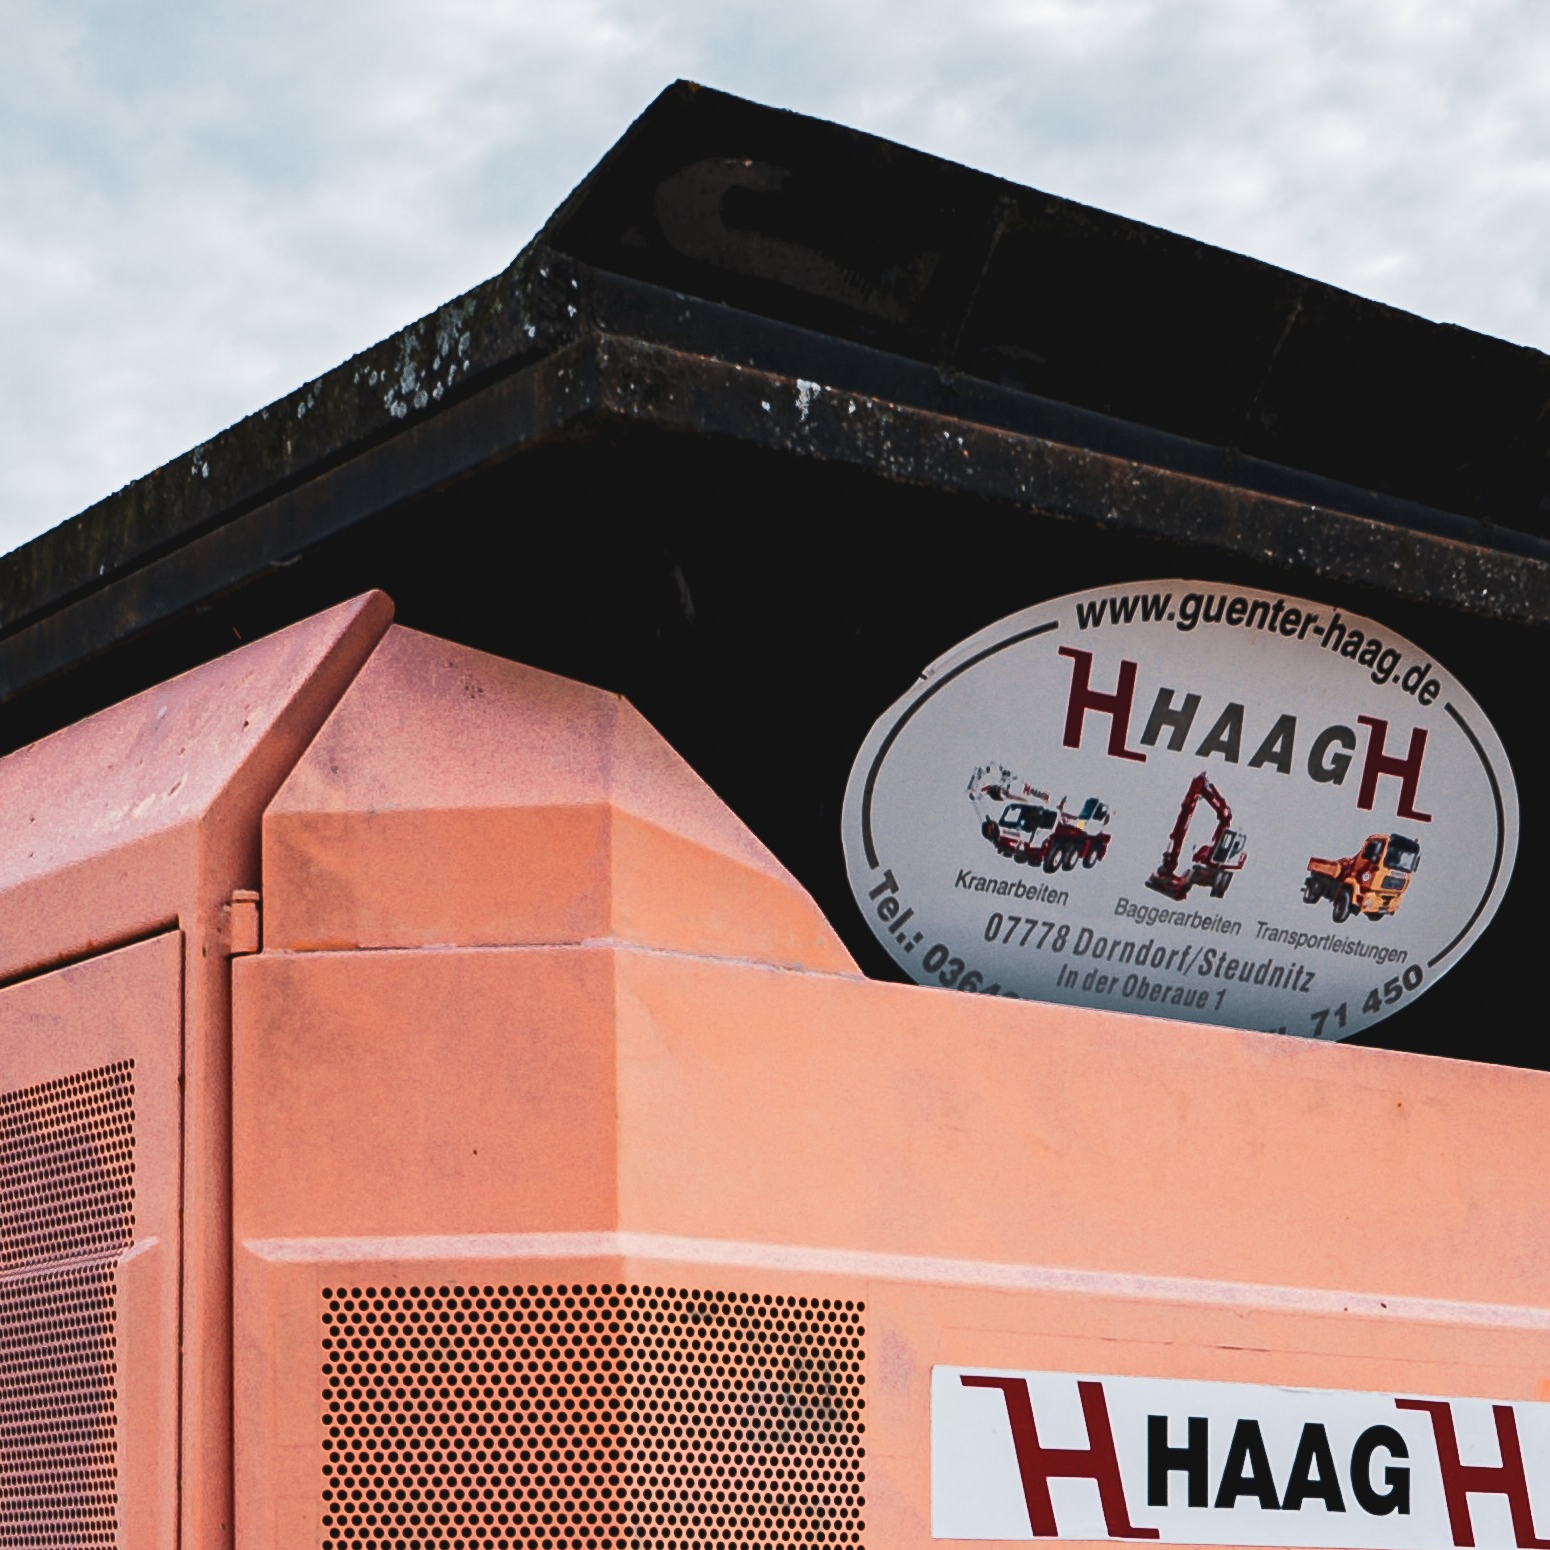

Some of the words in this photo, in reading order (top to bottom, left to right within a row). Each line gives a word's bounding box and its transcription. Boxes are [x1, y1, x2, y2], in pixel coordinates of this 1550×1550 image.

[1075, 592, 1441, 706] www.guenter-haag.de
[955, 869, 1069, 906] Kranarbeiten
[1114, 897, 1242, 936] Baggerarbeiten
[868, 869, 924, 953] Tel.:
[1310, 1002, 1348, 1037] 71
[1362, 964, 1424, 1014] 450
[984, 912, 1071, 953] 07778
[1072, 927, 1315, 993] Dorndorf/Steudnitz
[1255, 920, 1408, 965] Transportleistungen
[1056, 963, 1077, 988] In
[1082, 968, 1119, 994] der
[1123, 973, 1209, 1009] Oberaue
[1213, 988, 1227, 1011] 1
[1147, 1414, 1411, 1517] HAAG
